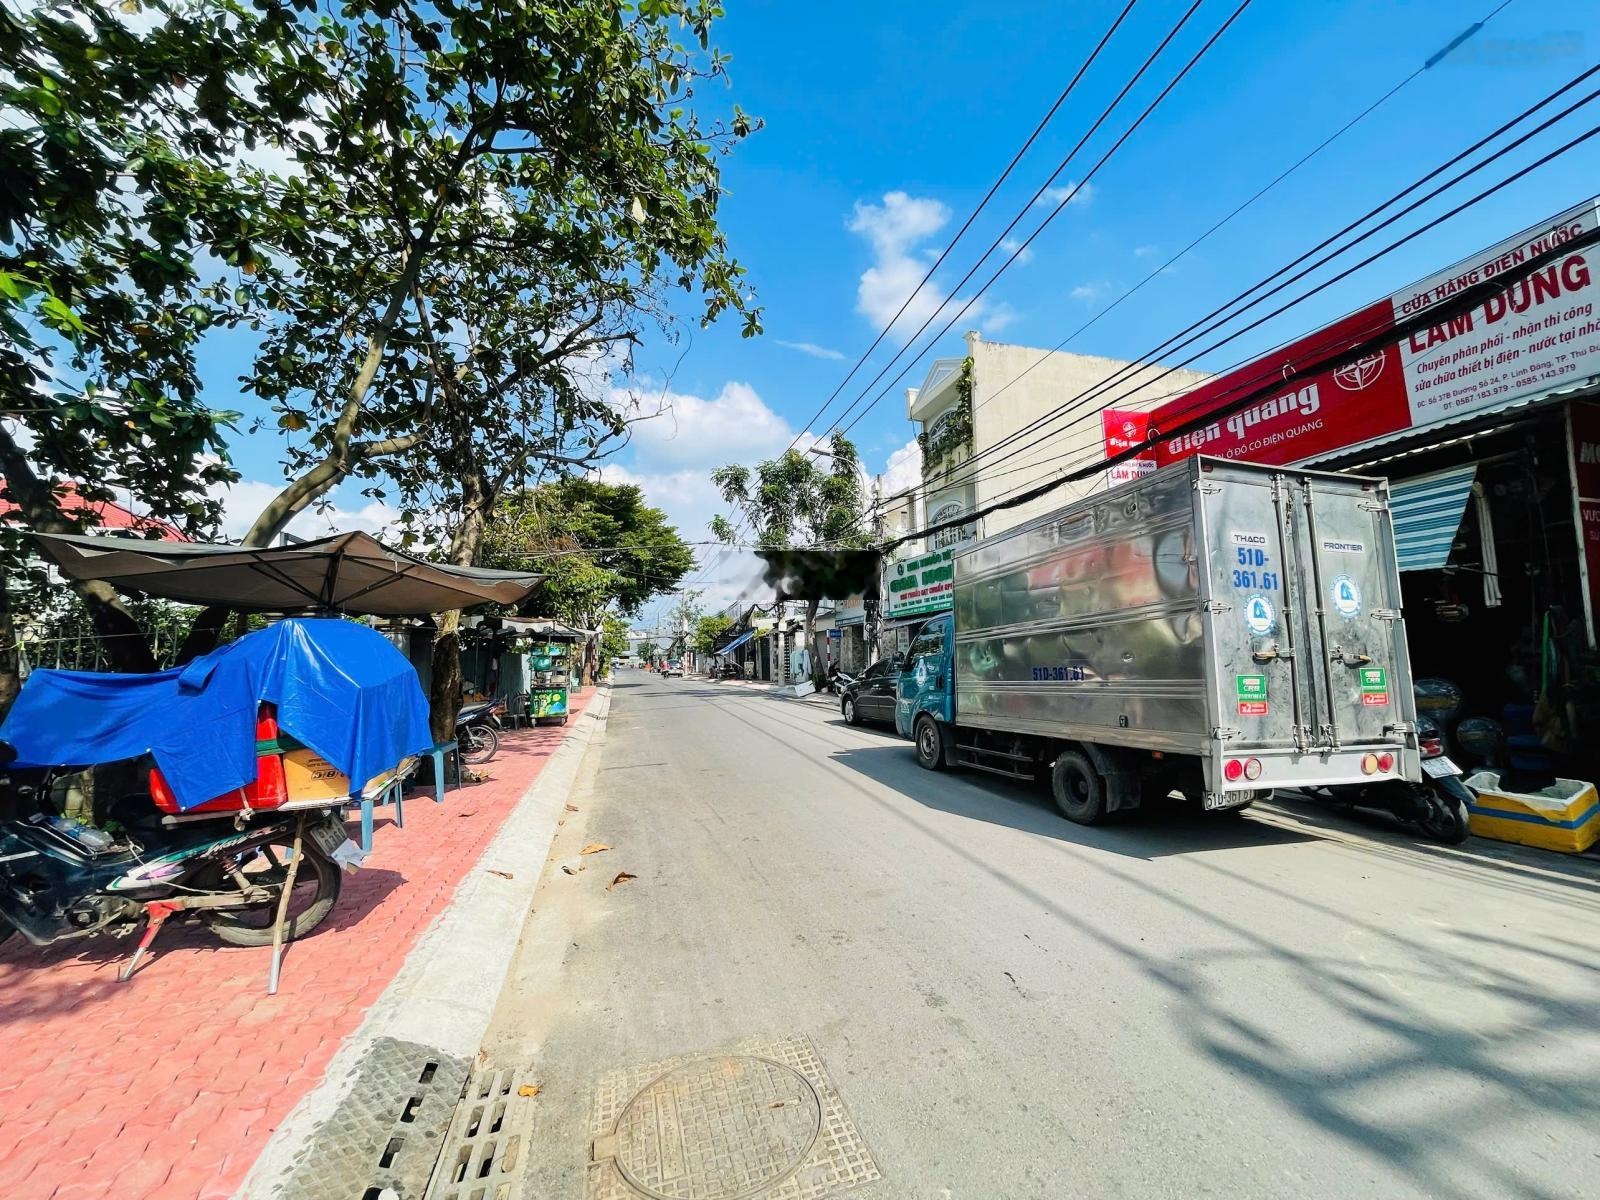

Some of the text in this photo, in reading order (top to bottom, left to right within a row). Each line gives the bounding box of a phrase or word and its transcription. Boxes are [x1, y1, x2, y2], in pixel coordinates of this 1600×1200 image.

[1435, 271, 1480, 299] HÀNG
[1417, 355, 1450, 374] Chuyên
[1453, 345, 1478, 364] phân
[1480, 332, 1504, 354] phối
[1512, 321, 1541, 341] nhận
[1544, 312, 1561, 329] thi
[1563, 303, 1593, 321] công
[1415, 379, 1431, 392] sửa
[1433, 371, 1456, 386] chữa
[1458, 359, 1482, 377] thiết
[1484, 355, 1494, 370] bị
[1496, 349, 1520, 365] điện
[1529, 336, 1557, 354] nước
[1559, 326, 1576, 344] tại
[1510, 368, 1528, 378] Linh
[1226, 382, 1321, 439] quang
[1248, 438, 1262, 451] CÓ
[1262, 431, 1285, 447] ĐIỆN
[1285, 419, 1324, 438] QUANG
[1234, 534, 1266, 544] THACO
[1323, 542, 1363, 551] FRONTIER
[1238, 547, 1269, 567] 51D-
[1233, 569, 1278, 590] 361.61
[1032, 666, 1084, 681] 51D-361.61
